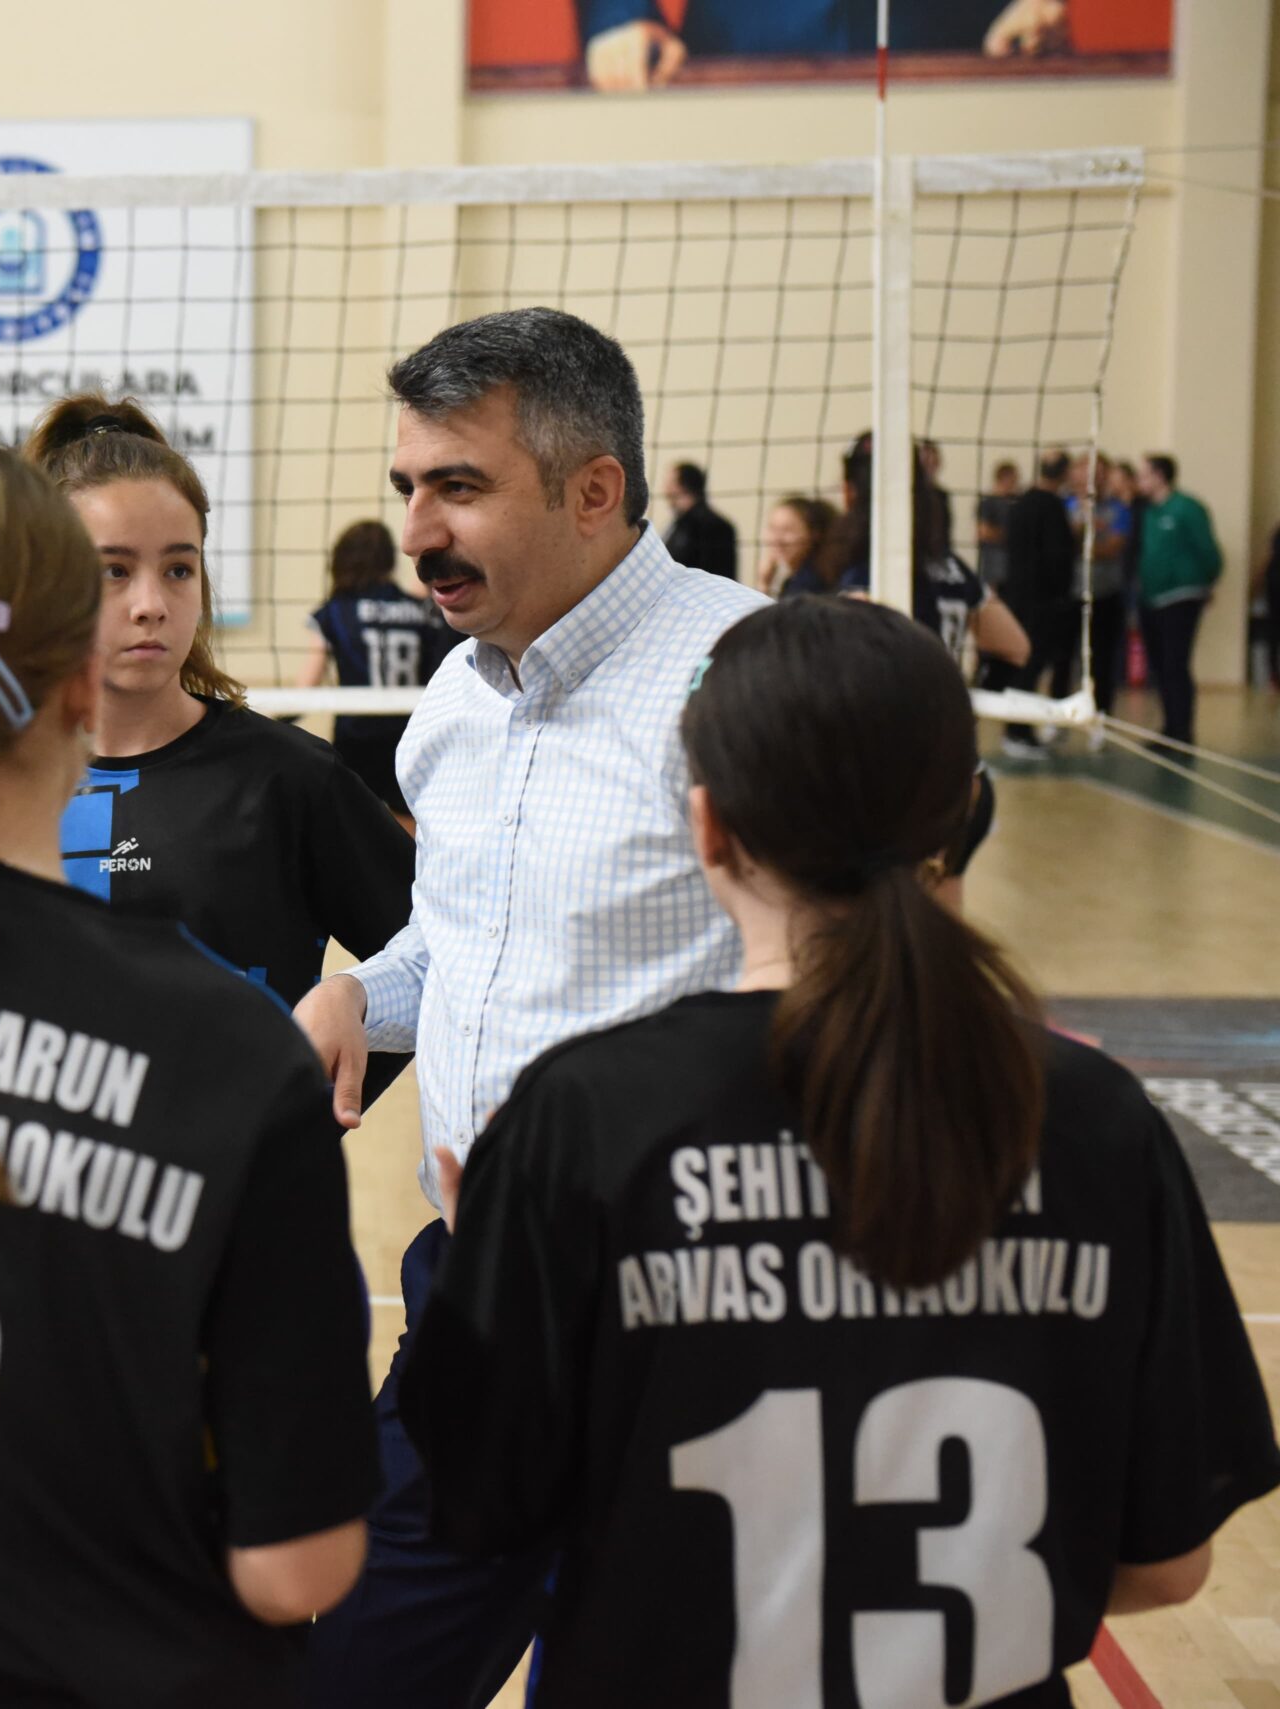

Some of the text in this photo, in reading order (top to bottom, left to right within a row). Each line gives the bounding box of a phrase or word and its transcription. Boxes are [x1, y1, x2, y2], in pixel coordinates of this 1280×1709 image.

[362, 627, 421, 686] 18
[99, 857, 151, 873] PERON
[619, 1242, 787, 1331] ARVAS
[670, 1375, 1054, 1709] 13
